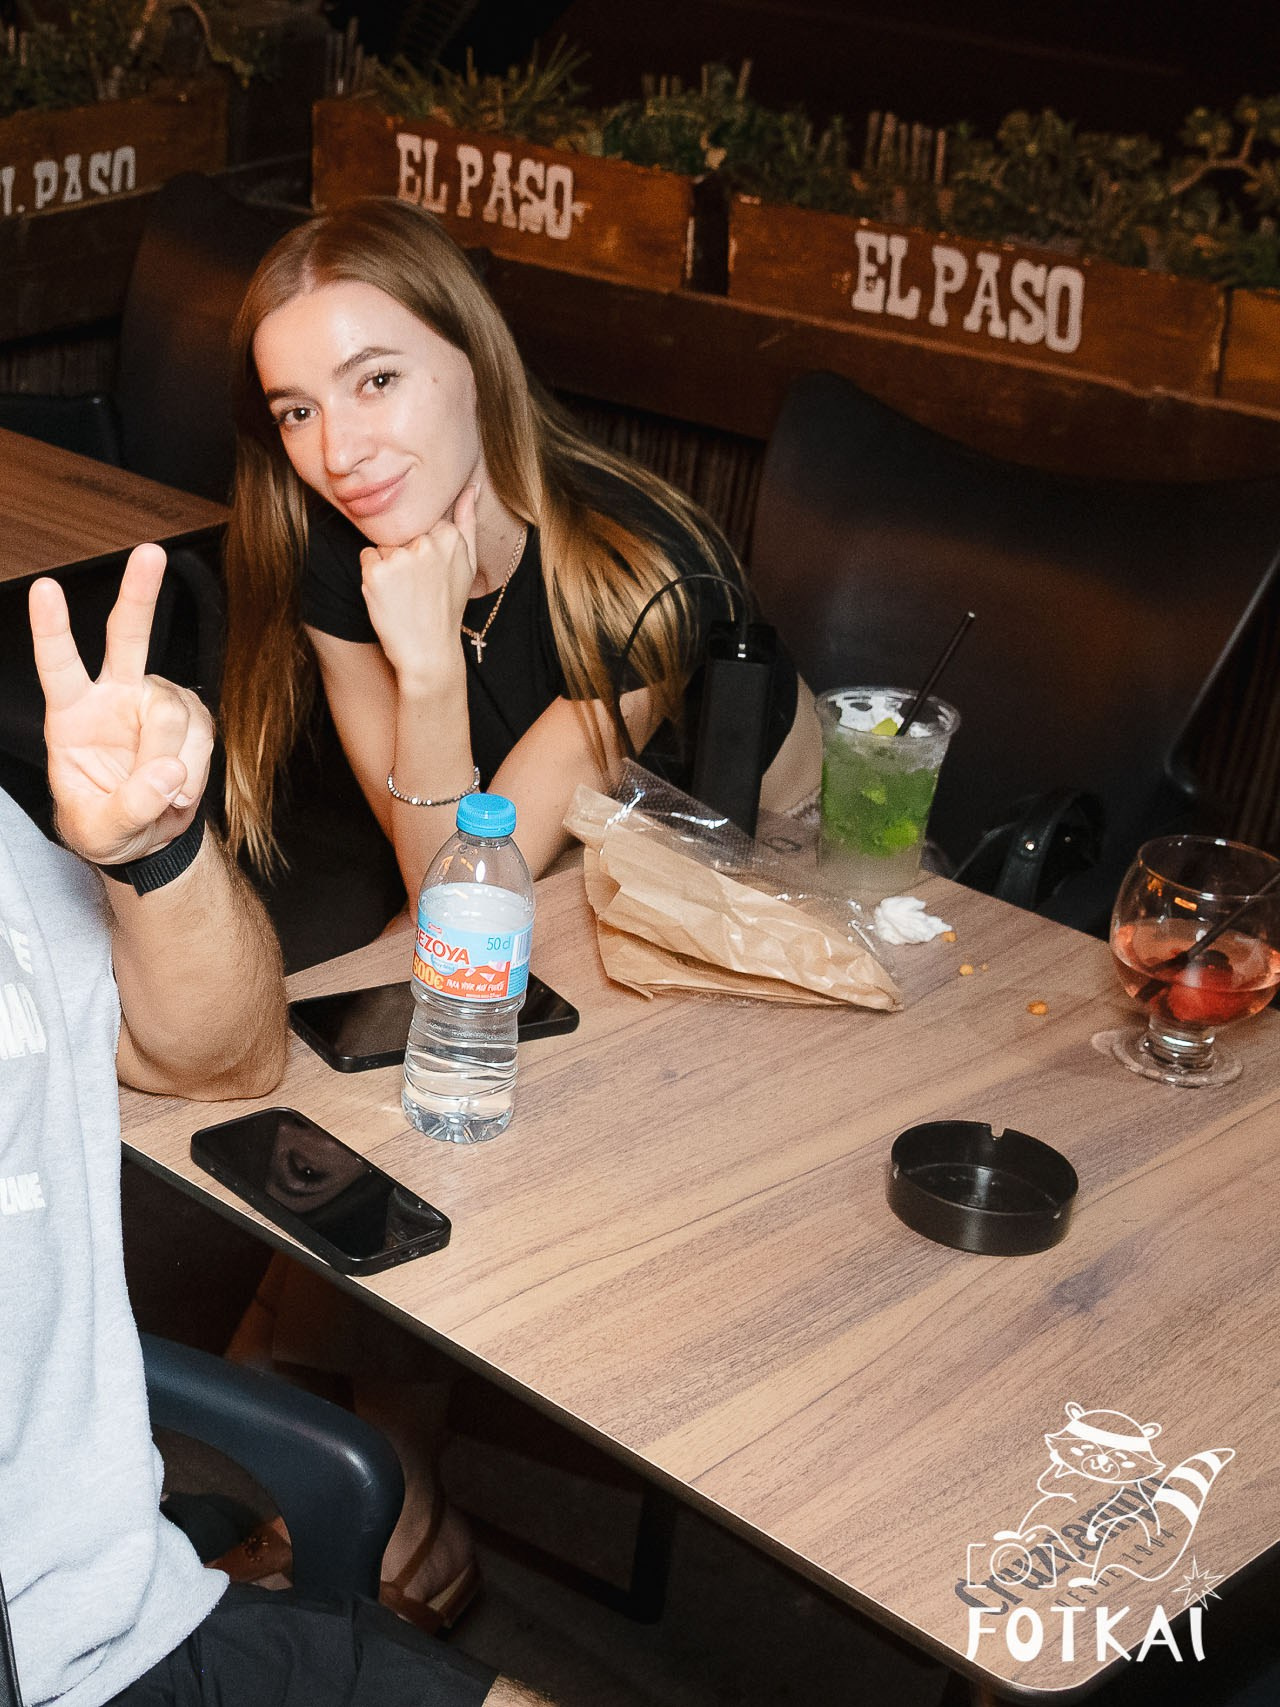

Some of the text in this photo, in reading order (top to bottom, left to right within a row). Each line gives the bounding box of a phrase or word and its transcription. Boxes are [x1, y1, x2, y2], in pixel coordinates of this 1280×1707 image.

[396, 132, 574, 240] EL PASO
[852, 230, 1084, 353] EL PASO
[486, 937, 501, 951] 50
